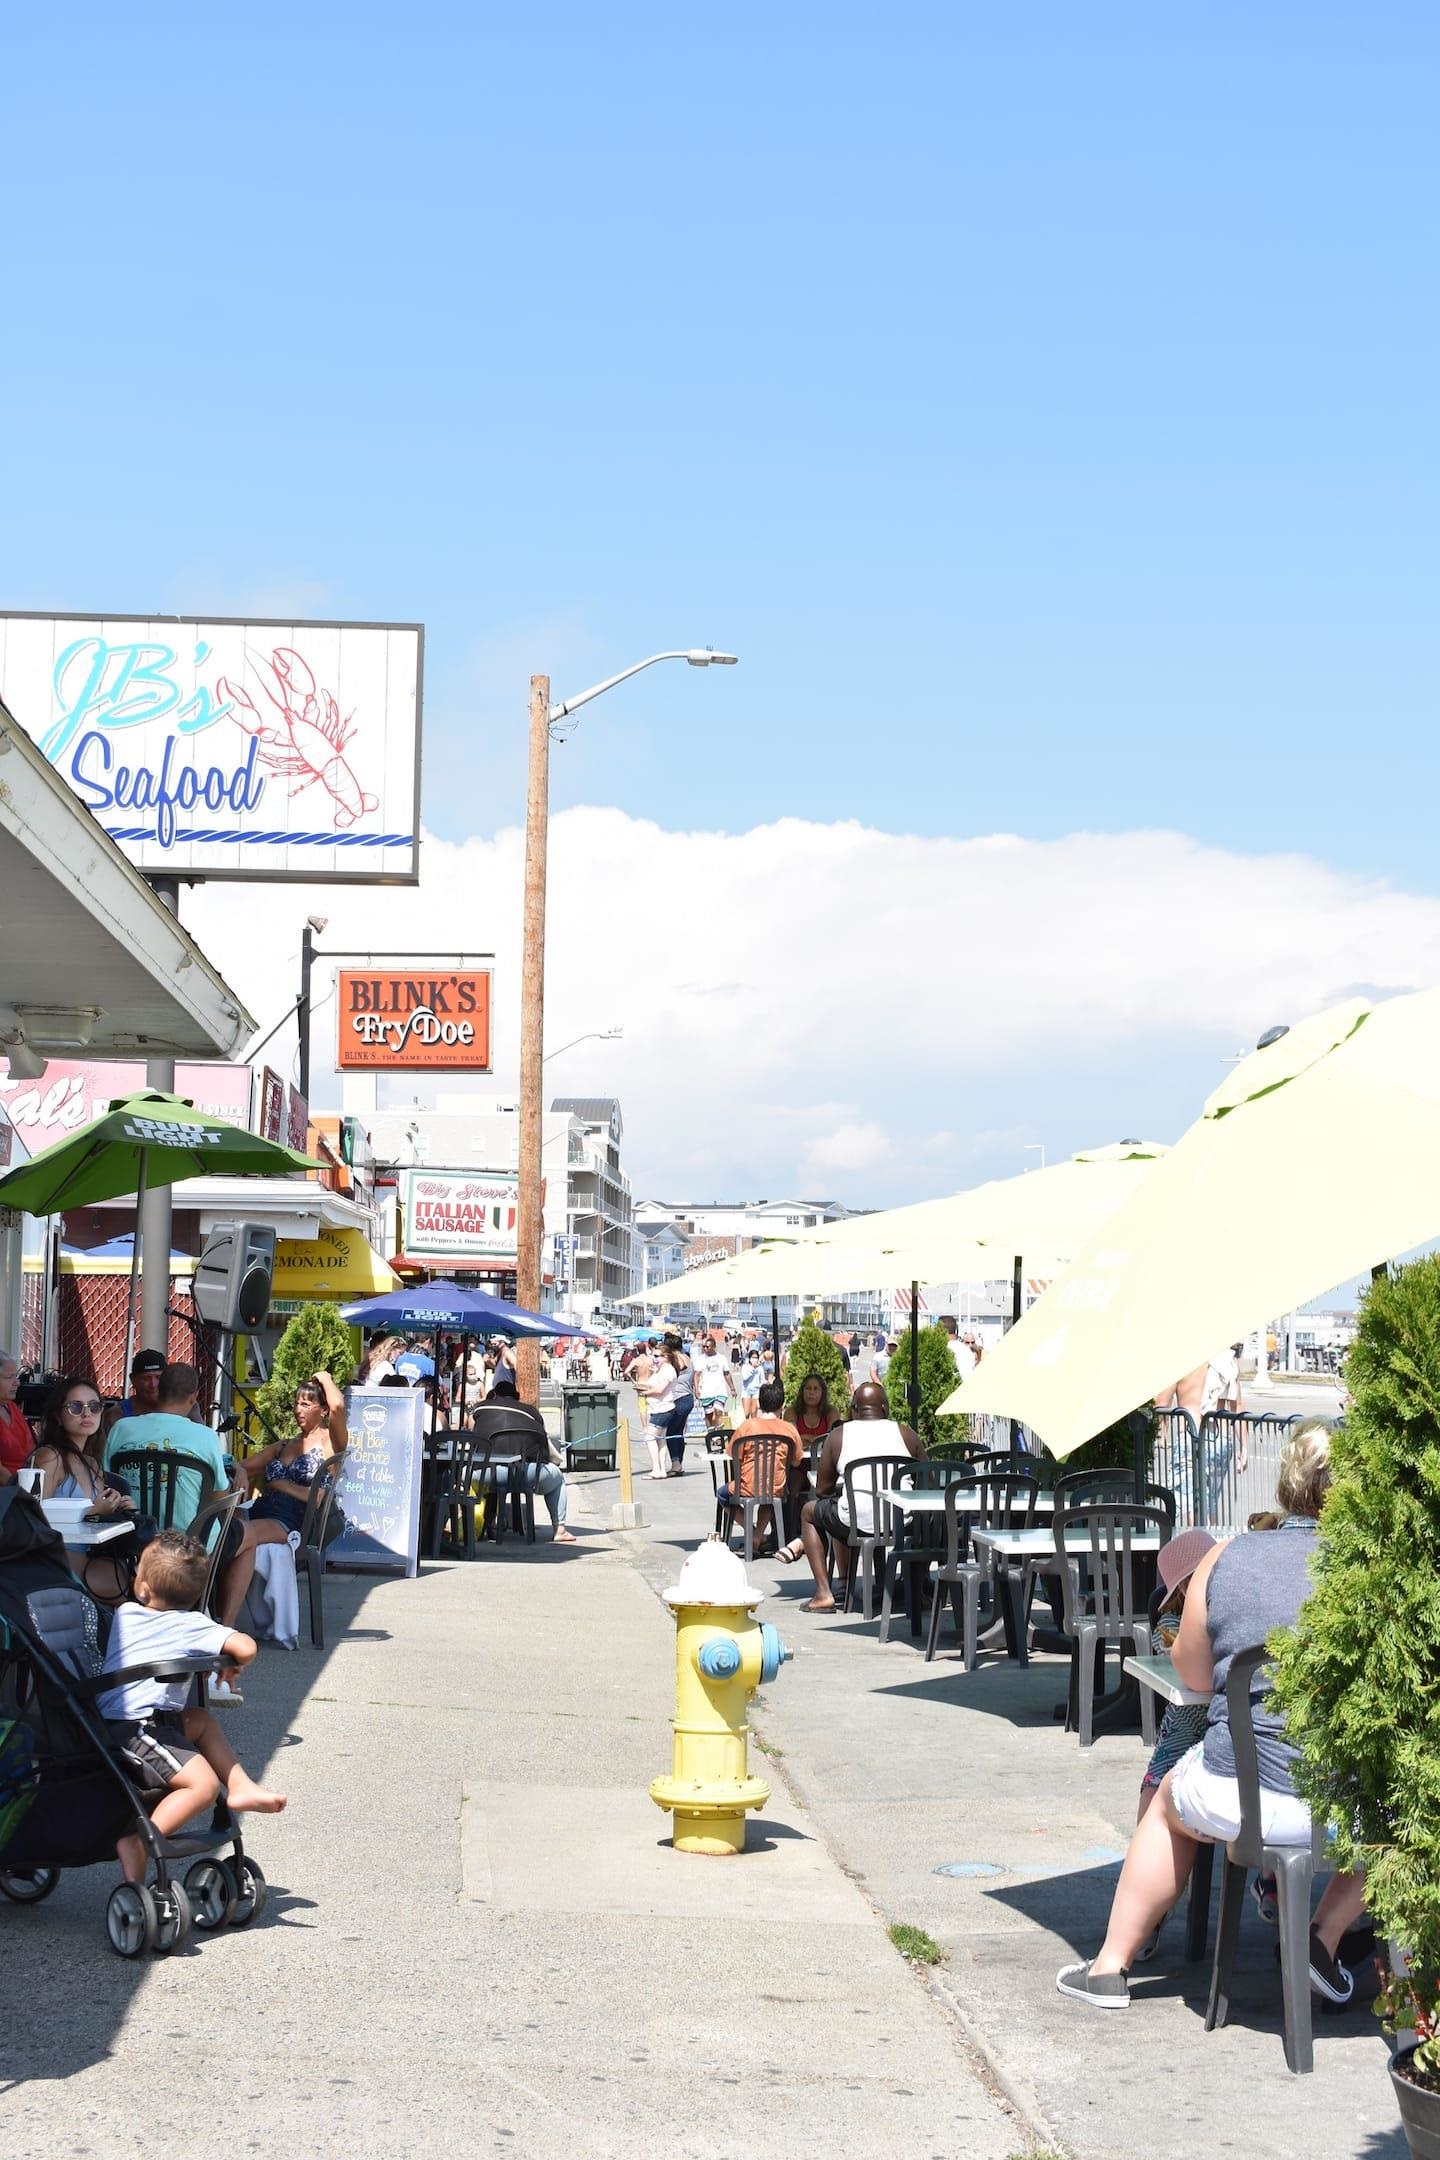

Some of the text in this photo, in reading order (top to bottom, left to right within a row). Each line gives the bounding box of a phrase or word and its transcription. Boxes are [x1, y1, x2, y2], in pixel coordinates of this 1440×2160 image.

[40, 636, 237, 763] JB's
[71, 730, 266, 848] Seafood
[348, 976, 477, 1013] BLINK'S
[352, 1005, 475, 1052] Fry Doe
[131, 1117, 205, 1133] BUD
[123, 1125, 222, 1144] LIGHT
[416, 1181, 519, 1200] Big Steve's
[415, 1202, 486, 1220] ITALIAN
[415, 1217, 486, 1234] SAUSAGE
[430, 1237, 457, 1245] Peppers
[404, 1314, 460, 1322] LIGHT
[412, 1309, 452, 1317] BUD
